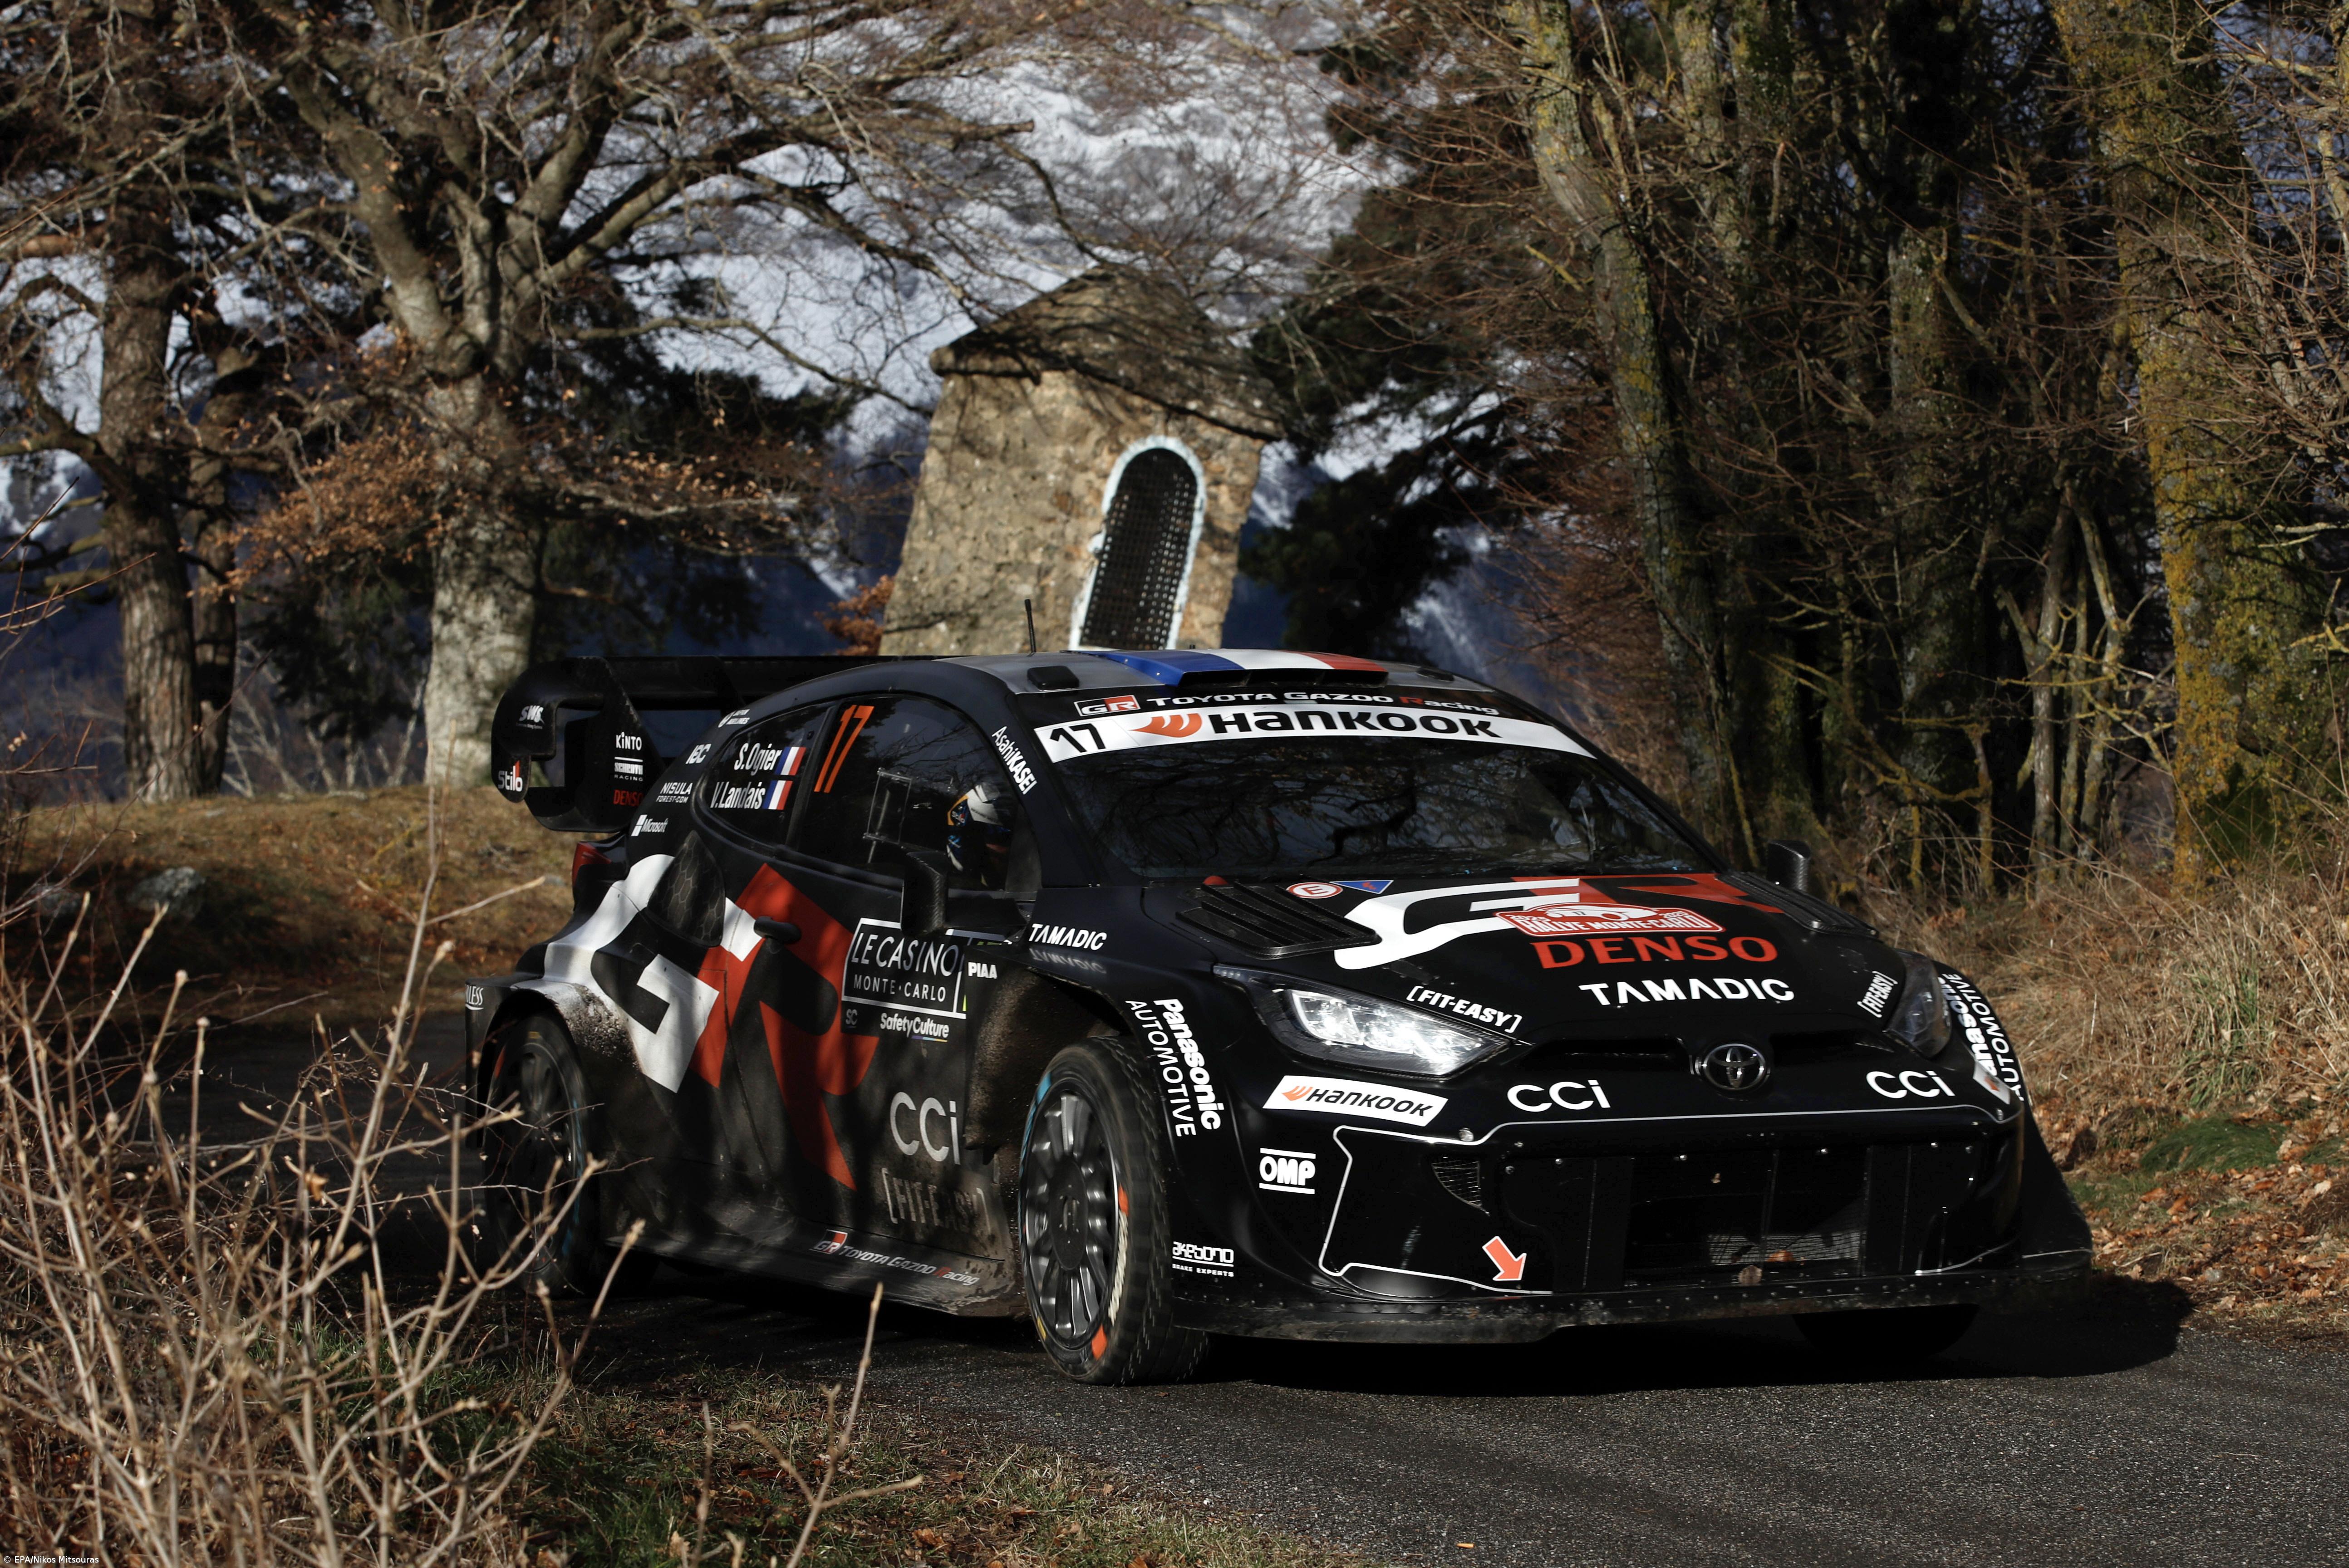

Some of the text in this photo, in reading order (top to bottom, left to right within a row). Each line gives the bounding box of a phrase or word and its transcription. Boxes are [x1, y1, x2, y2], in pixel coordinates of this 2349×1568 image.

[519, 705, 544, 723] SWS
[1081, 692, 1499, 715] GR TOYOTA GAZOO Racing
[814, 705, 874, 794] 17
[1050, 723, 1106, 753] 17
[734, 743, 782, 776] S.Ogier
[660, 782, 693, 794] NISULA
[710, 782, 766, 809] V.Landais
[641, 818, 668, 833] Microsoft
[1028, 923, 1107, 951] TAMADIC
[1513, 919, 1590, 933] RALLYE
[1530, 936, 1778, 969] DENSO
[968, 962, 998, 979] PIAA
[1579, 978, 1795, 1006] TAMADIC
[1125, 1000, 1197, 1137] AUTOMOTIVE
[1153, 999, 1225, 1130] Panasonic
[1259, 1156, 1316, 1186] OMP
[838, 1245, 890, 1264] TOYOTA
[887, 1256, 937, 1274] GAZOO
[933, 1266, 980, 1286] Racing
[1172, 1264, 1234, 1277] BRAKE EXPERTS
